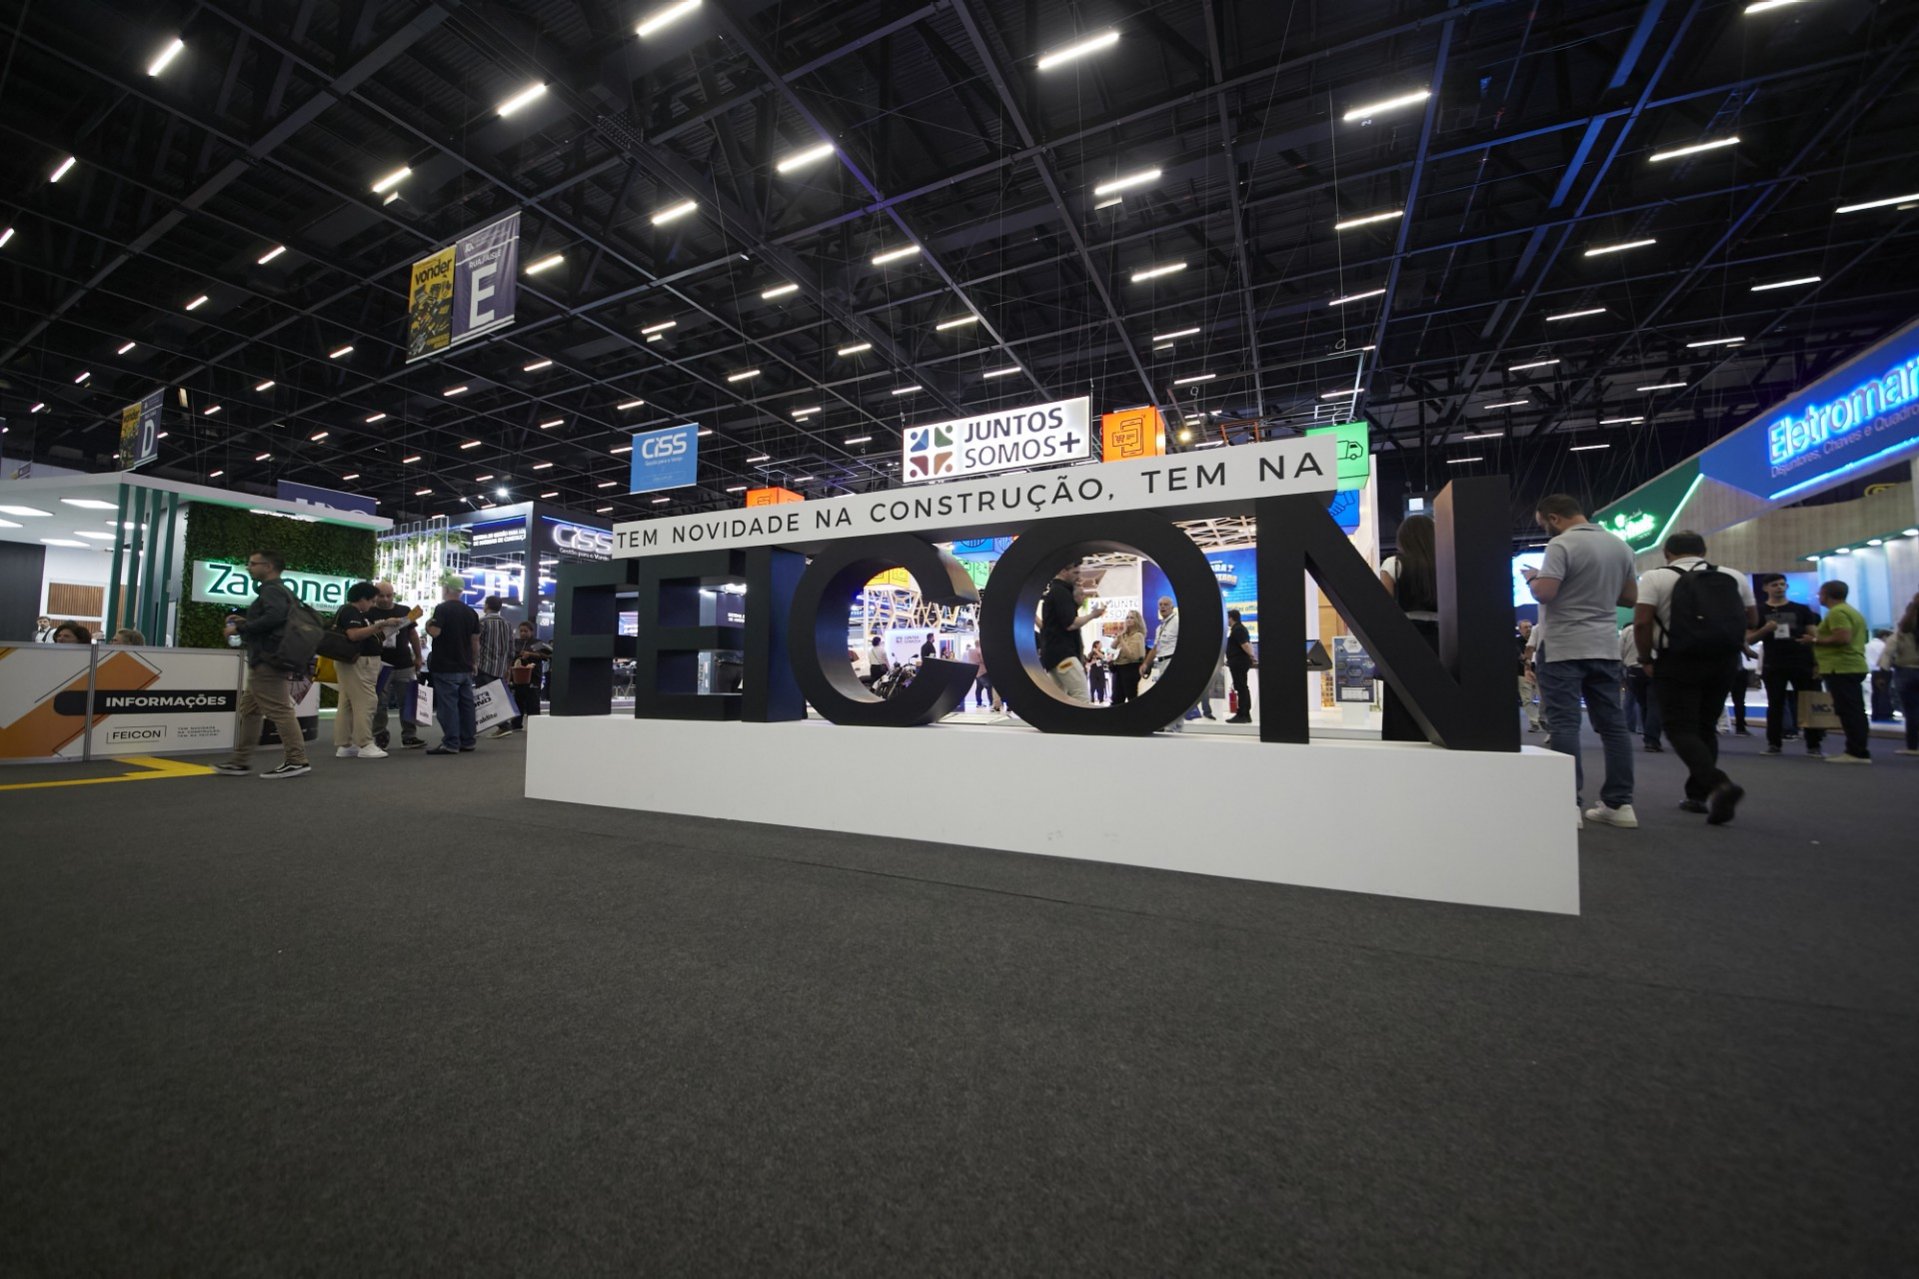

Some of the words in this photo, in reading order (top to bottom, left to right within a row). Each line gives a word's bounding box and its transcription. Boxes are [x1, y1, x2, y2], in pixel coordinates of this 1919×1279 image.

[415, 258, 452, 286] vonder
[469, 262, 498, 330] E
[141, 419, 155, 459] D
[965, 407, 1063, 443] JUNTOS
[617, 528, 658, 549] TEM
[673, 513, 799, 544] NOVIDADE
[816, 507, 852, 529] NA
[870, 475, 1114, 523] CONSTRUÇÃO,
[1141, 462, 1226, 494] TEM
[1260, 452, 1324, 482] NA
[549, 476, 1521, 752] FEICON
[106, 693, 226, 708] INFORMAÇÕES
[112, 730, 161, 740] FEICON
